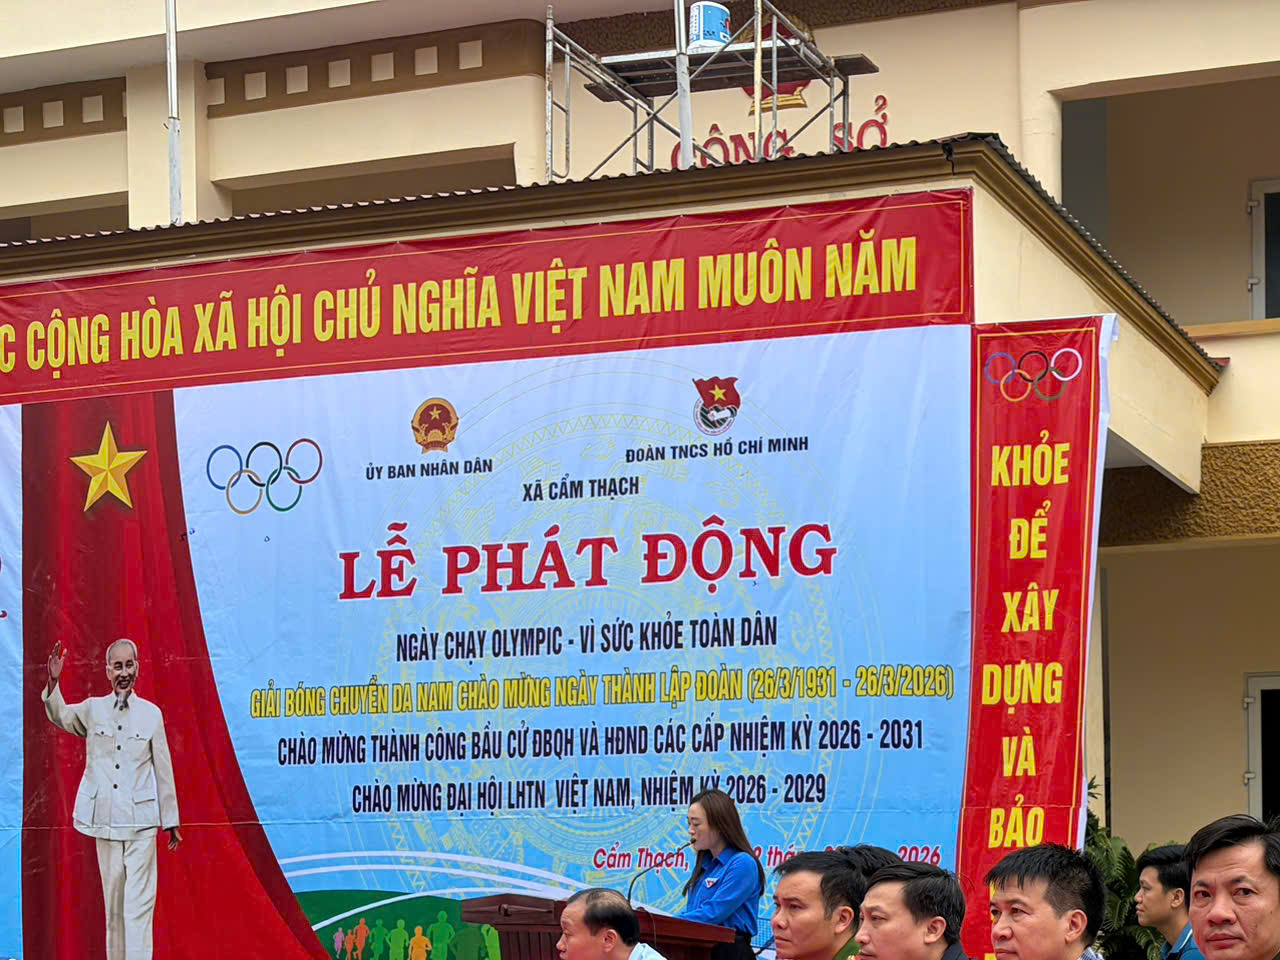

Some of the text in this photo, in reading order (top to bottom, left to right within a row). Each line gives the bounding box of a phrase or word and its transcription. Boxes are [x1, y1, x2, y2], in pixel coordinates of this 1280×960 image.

[833, 95, 888, 152] SỞ
[27, 310, 110, 378] CỘNG
[121, 297, 183, 360] HÒA
[194, 290, 237, 353] XÃ
[248, 285, 302, 357] HỘI
[313, 269, 381, 340] CHỦ
[392, 267, 501, 334] NGHĨA
[512, 258, 587, 333] VIỆT
[600, 258, 685, 318] NAM
[698, 238, 812, 309] MUÔN
[825, 229, 917, 298] NĂM
[366, 457, 493, 480] ỦY BAN NHÂN DÂN
[625, 436, 809, 463] ĐOÀN TNCS HỒ CHÍ MINH
[991, 430, 1071, 487] KHỎE
[523, 473, 640, 502] XÃ CẨM THẠCH
[1009, 500, 1051, 559] ĐỂ
[338, 514, 837, 600] LỄ PHÁT ĐỘNG
[1001, 582, 1059, 633] XÂY
[396, 627, 439, 662] NGÀY
[444, 630, 487, 665] CHẠY
[492, 626, 562, 657] OLYMPIC
[580, 619, 595, 653] VÌ
[600, 617, 634, 653] SỨC
[639, 611, 684, 650] KHỎE
[690, 613, 735, 648] TOÀN
[741, 611, 778, 647] DÂN
[251, 679, 281, 718] GIẢI
[284, 681, 326, 717] BÓNG
[392, 683, 413, 713] DA
[417, 681, 454, 712] NAM
[457, 673, 499, 711] CHÀO
[503, 672, 551, 709] MỪNG
[555, 669, 598, 707] NGÀY
[602, 667, 656, 704] THÀNH
[660, 665, 691, 709] LẬP
[694, 663, 743, 701] ĐOÀN
[748, 666, 837, 702] (26/3/1931
[855, 664, 954, 700] 26/3/2026)
[981, 659, 1064, 714] DỰNG
[277, 731, 317, 765] CHÀO
[322, 730, 366, 764] MỪNG
[371, 729, 420, 762] THÀNH
[425, 727, 466, 760] CÔNG
[471, 721, 502, 760] BẦU
[507, 720, 529, 759] CỬ
[532, 728, 574, 760] ĐBQH
[579, 721, 599, 756] VÀ
[604, 725, 648, 755] HĐND
[654, 717, 686, 754] CÁC
[692, 712, 725, 753] CẤP
[730, 716, 785, 757] NHIỆM
[791, 714, 813, 751] KỲ
[818, 720, 861, 750] 2026
[879, 719, 923, 749] 2031
[1002, 726, 1037, 777] VÀ
[352, 778, 392, 813] CHÀO
[397, 777, 442, 812] MỪNG
[446, 780, 472, 817] ĐẠI
[477, 775, 502, 816] HỘI
[507, 780, 546, 809] LHTN
[555, 772, 589, 815] VIỆT
[593, 778, 636, 810] NAM,
[641, 770, 694, 812] NHIỆM
[726, 775, 766, 804] 2026
[784, 772, 827, 804] 2029
[988, 793, 1045, 849] BẢO
[593, 841, 632, 868] Cẩm
[637, 848, 689, 874] Thạch,
[767, 844, 800, 866] thá
[898, 845, 941, 866] 2026
